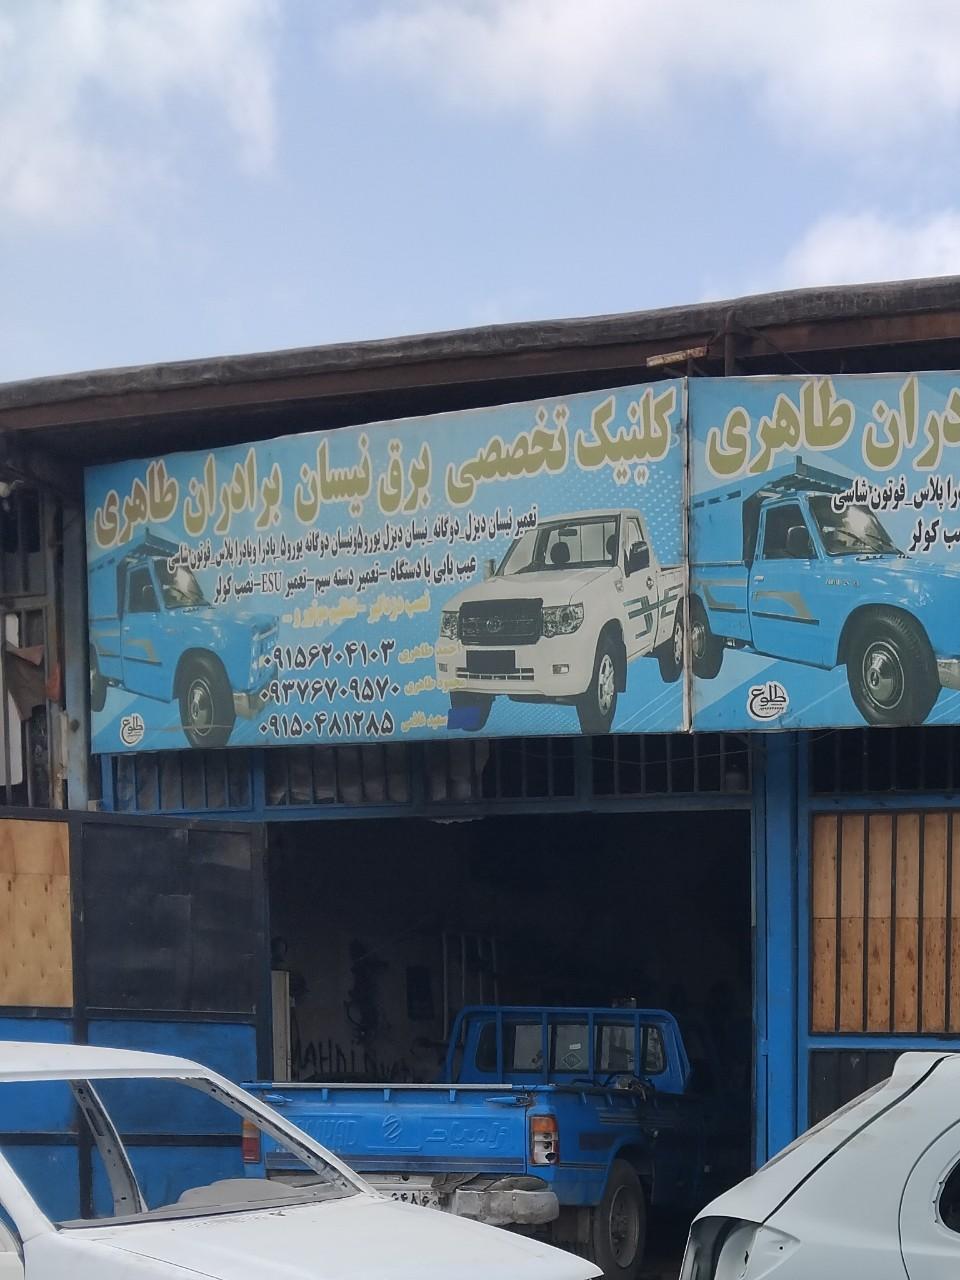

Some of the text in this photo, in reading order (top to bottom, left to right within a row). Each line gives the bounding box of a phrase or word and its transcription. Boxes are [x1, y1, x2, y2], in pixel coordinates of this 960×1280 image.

[708, 376, 853, 474] طاهری
[95, 389, 676, 546] کلینیک تخصصی برق نیسان برادران طاهری
[489, 509, 512, 539] نیسان
[908, 518, 940, 551] کولر
[424, 556, 431, 583] با
[264, 640, 395, 670] ۰۹۱۵۶۲۰۴۱۰۳
[260, 676, 400, 704] ۰۹۳۷۶۷۰۹۵۷۰
[749, 684, 787, 719] طلوع
[260, 711, 394, 739] ۰۹۱۵۰۴۸۱۲۸۵
